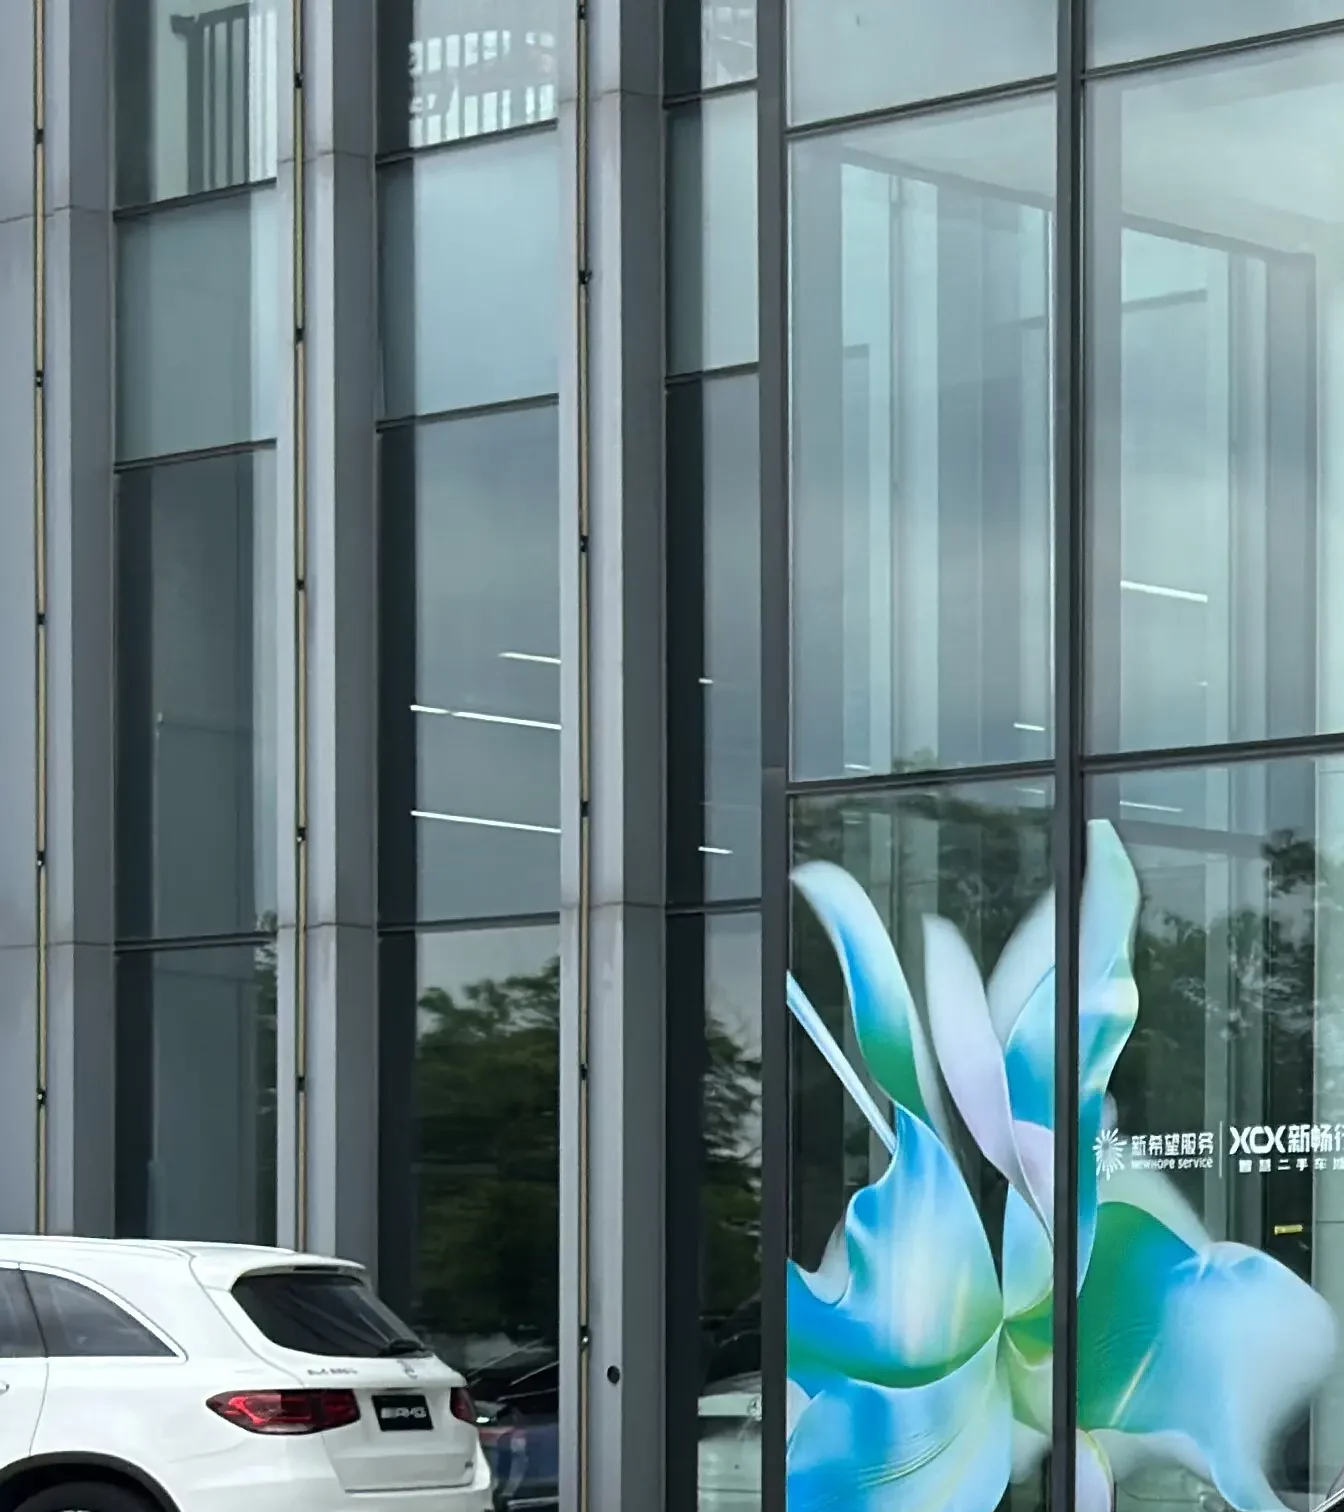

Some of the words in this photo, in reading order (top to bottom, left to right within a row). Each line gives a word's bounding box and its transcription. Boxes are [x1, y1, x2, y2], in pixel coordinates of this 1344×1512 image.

[1131, 1132, 1214, 1156] 新希望服务
